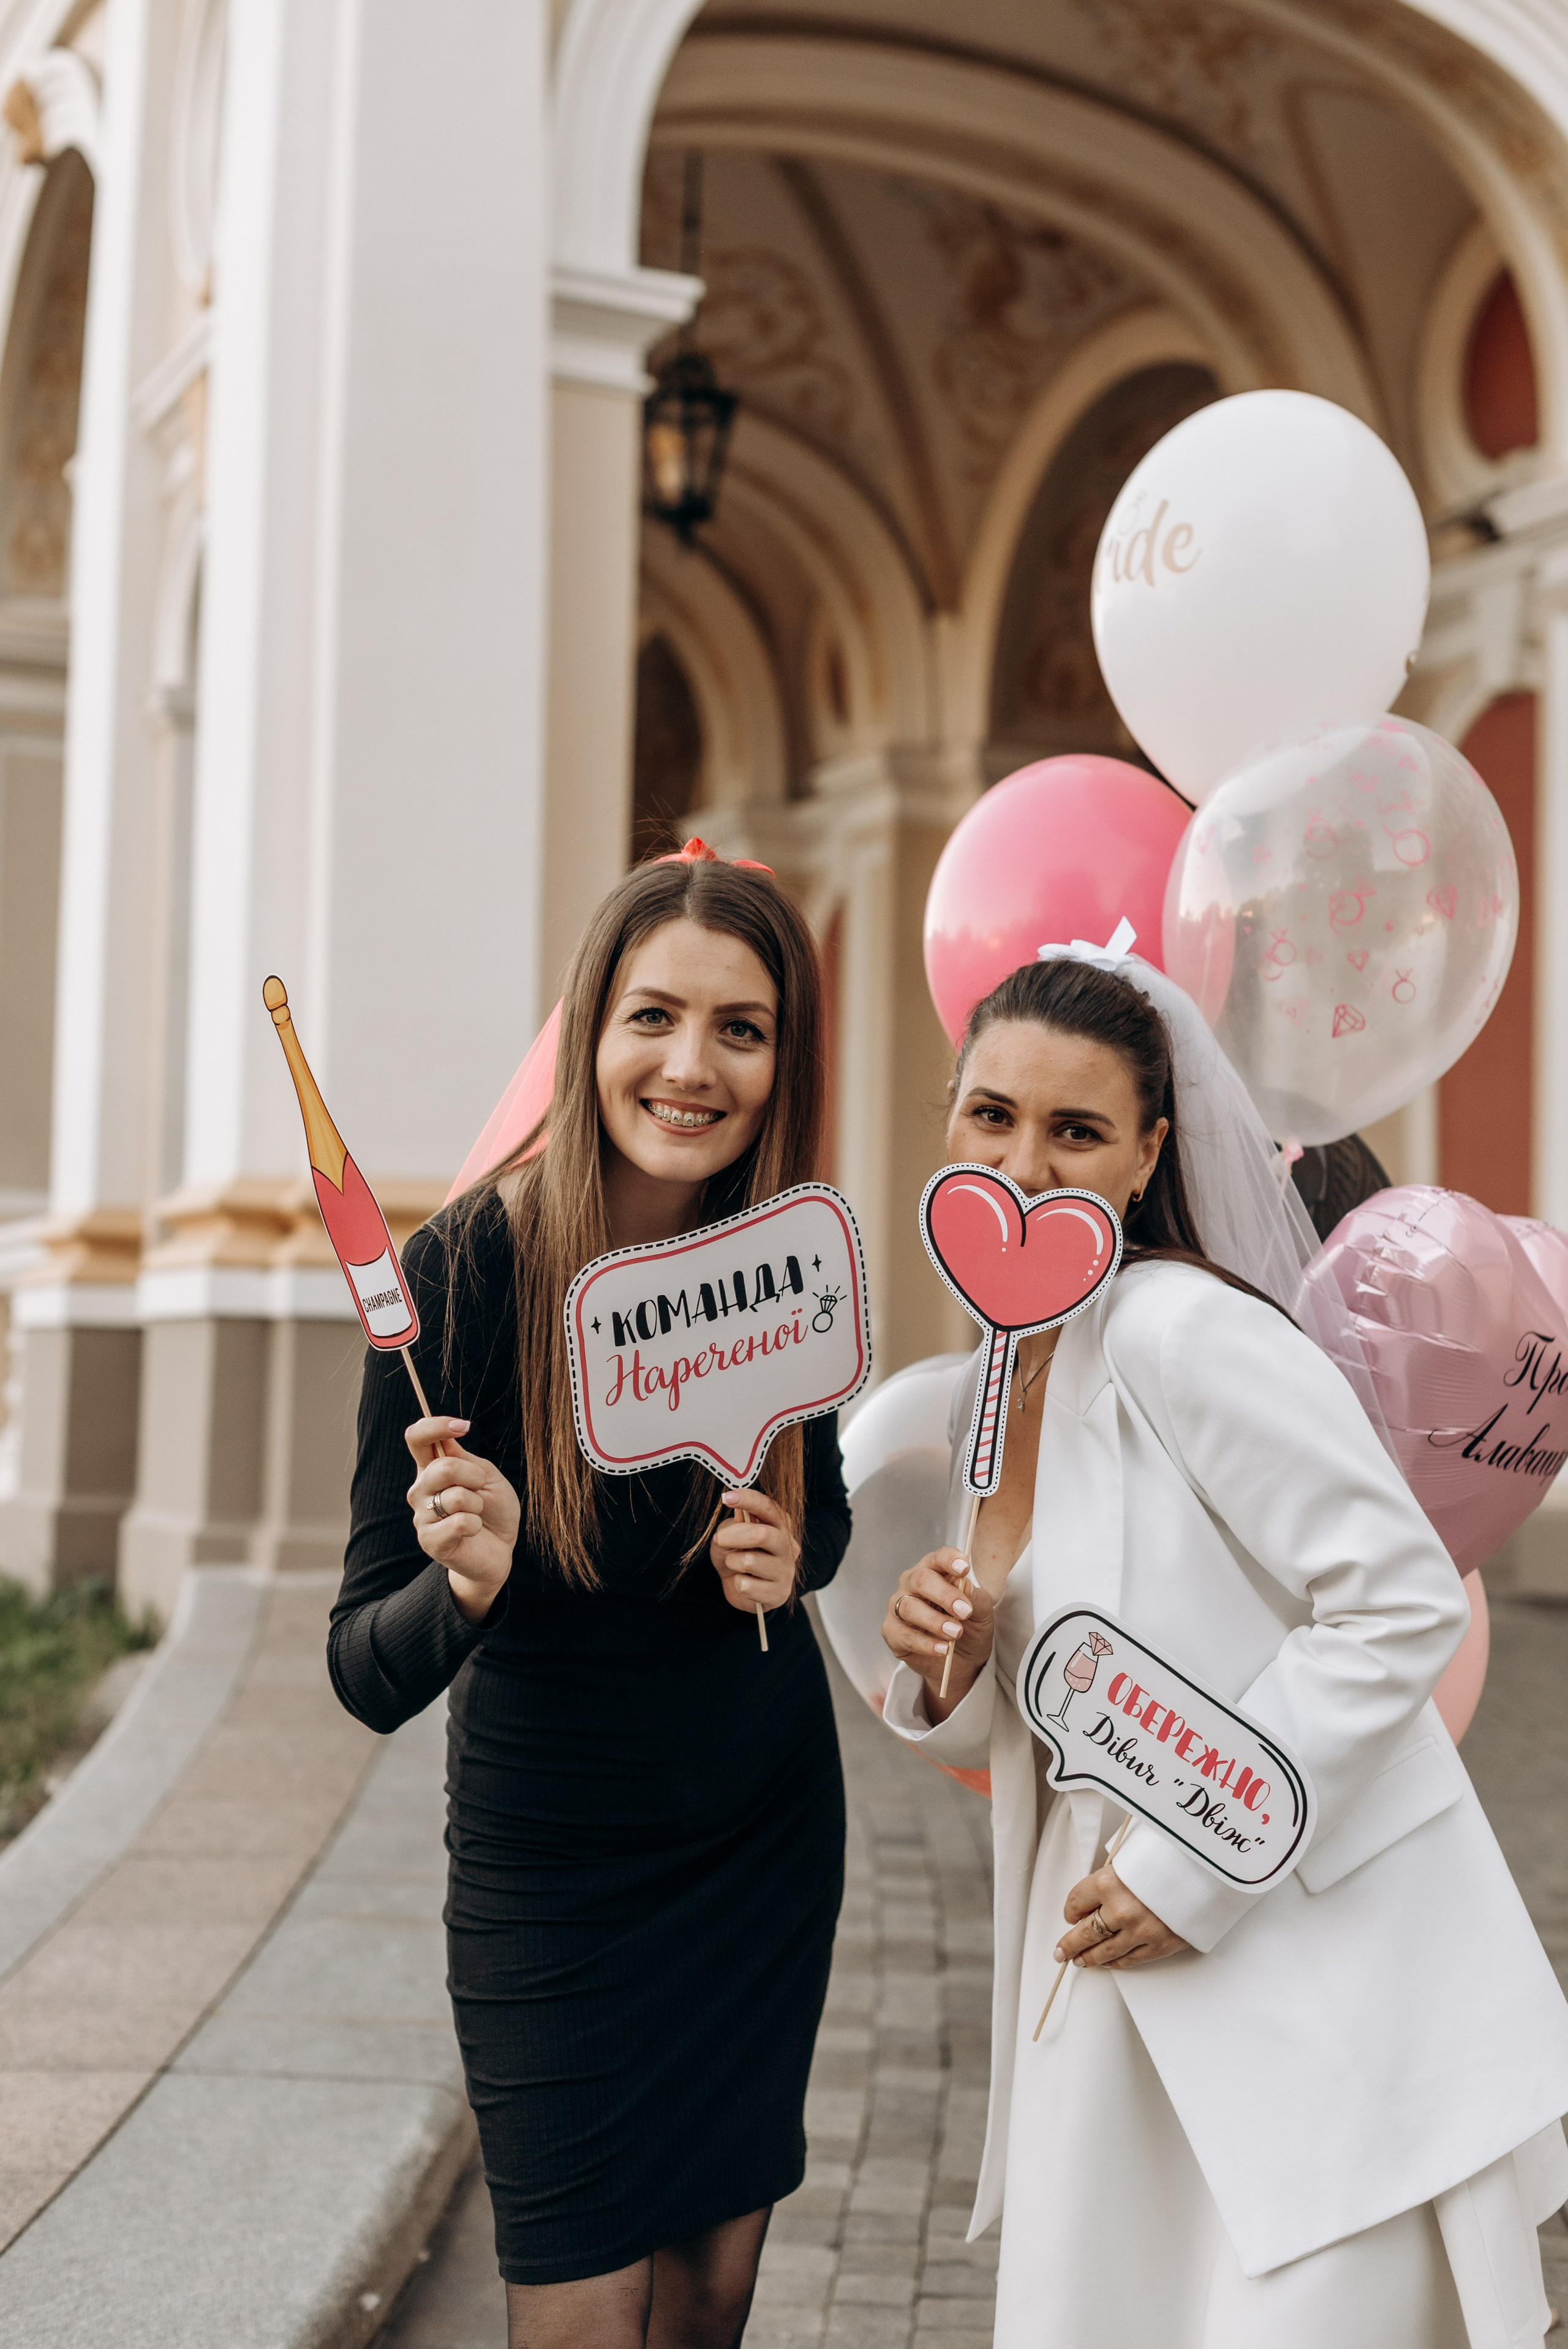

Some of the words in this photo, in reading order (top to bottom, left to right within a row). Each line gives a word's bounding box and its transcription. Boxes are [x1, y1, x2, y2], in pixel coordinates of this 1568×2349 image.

[362, 1287, 402, 1313] CHAMPAGNE
[612, 1255, 804, 1347] КОМАНДА
[605, 1307, 809, 1412] Нареченої
[1107, 1672, 1271, 1826] ОБЕРЕЖНО,
